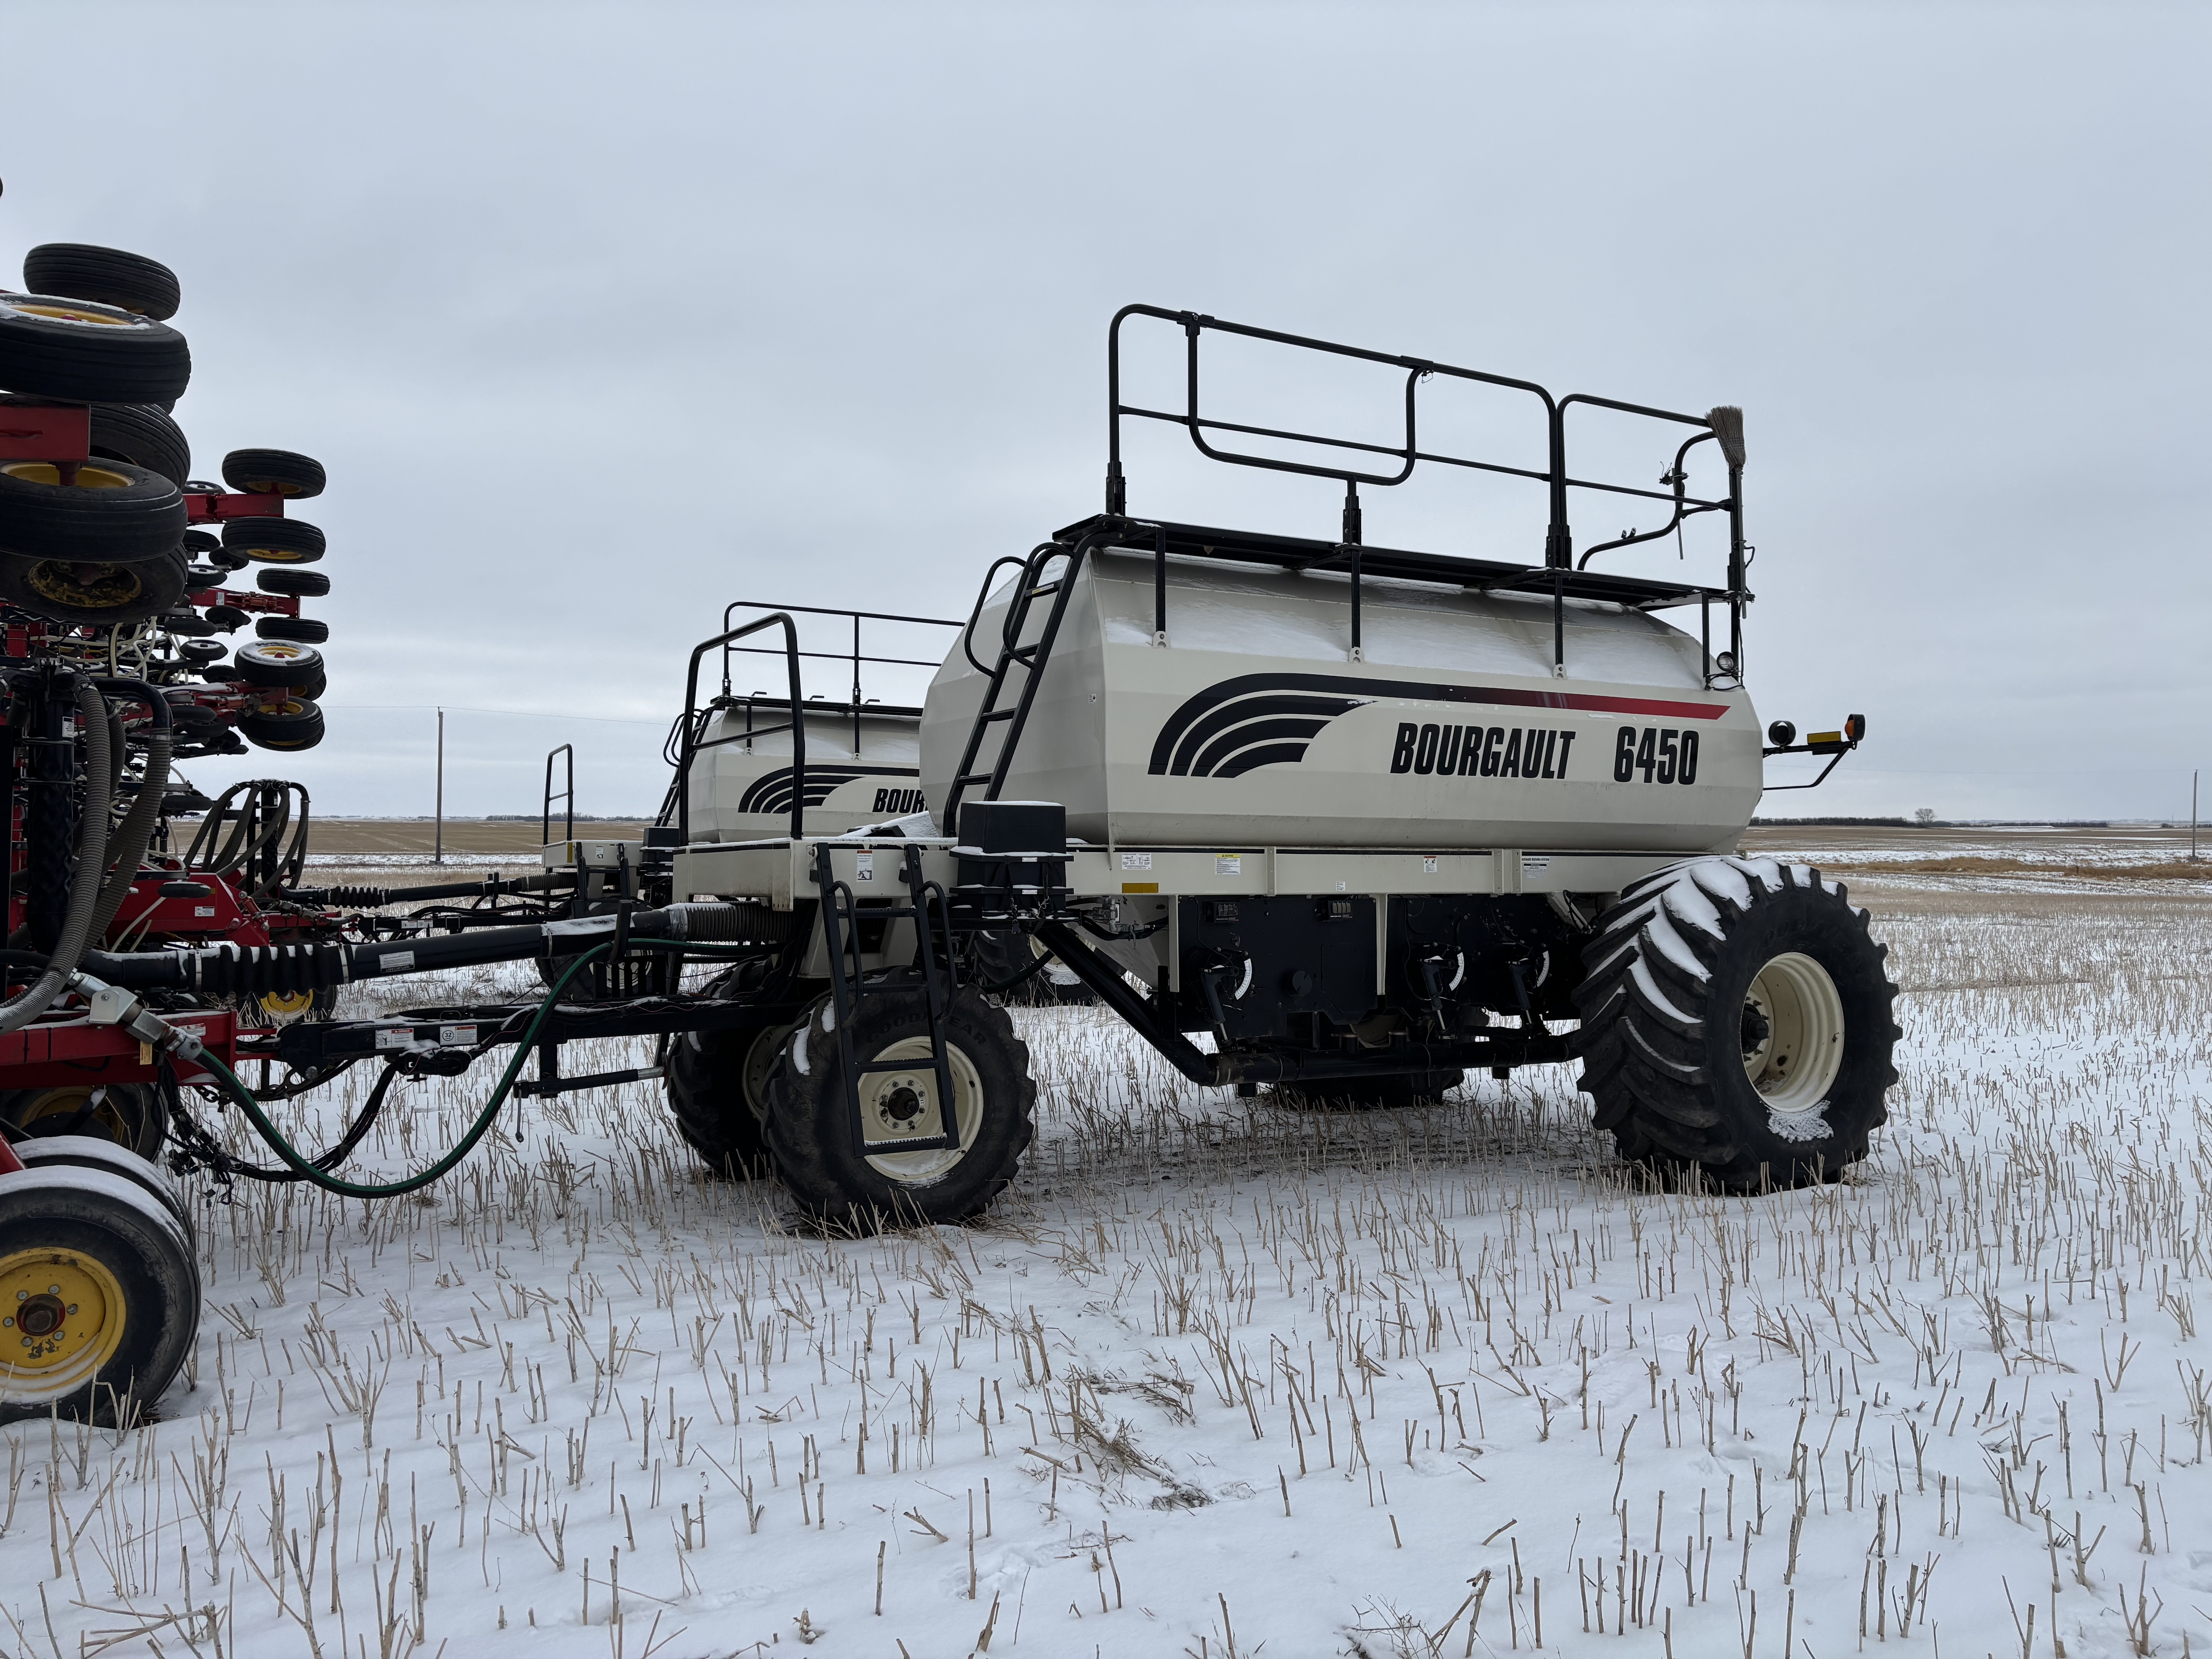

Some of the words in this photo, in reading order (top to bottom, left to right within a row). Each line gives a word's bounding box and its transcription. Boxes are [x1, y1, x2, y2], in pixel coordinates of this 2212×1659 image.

[1390, 722, 1576, 779] BOURGAULT
[1614, 726, 1699, 785] 6450
[872, 788, 929, 814] BOUR
[867, 1013, 986, 1045] GOODEAR
